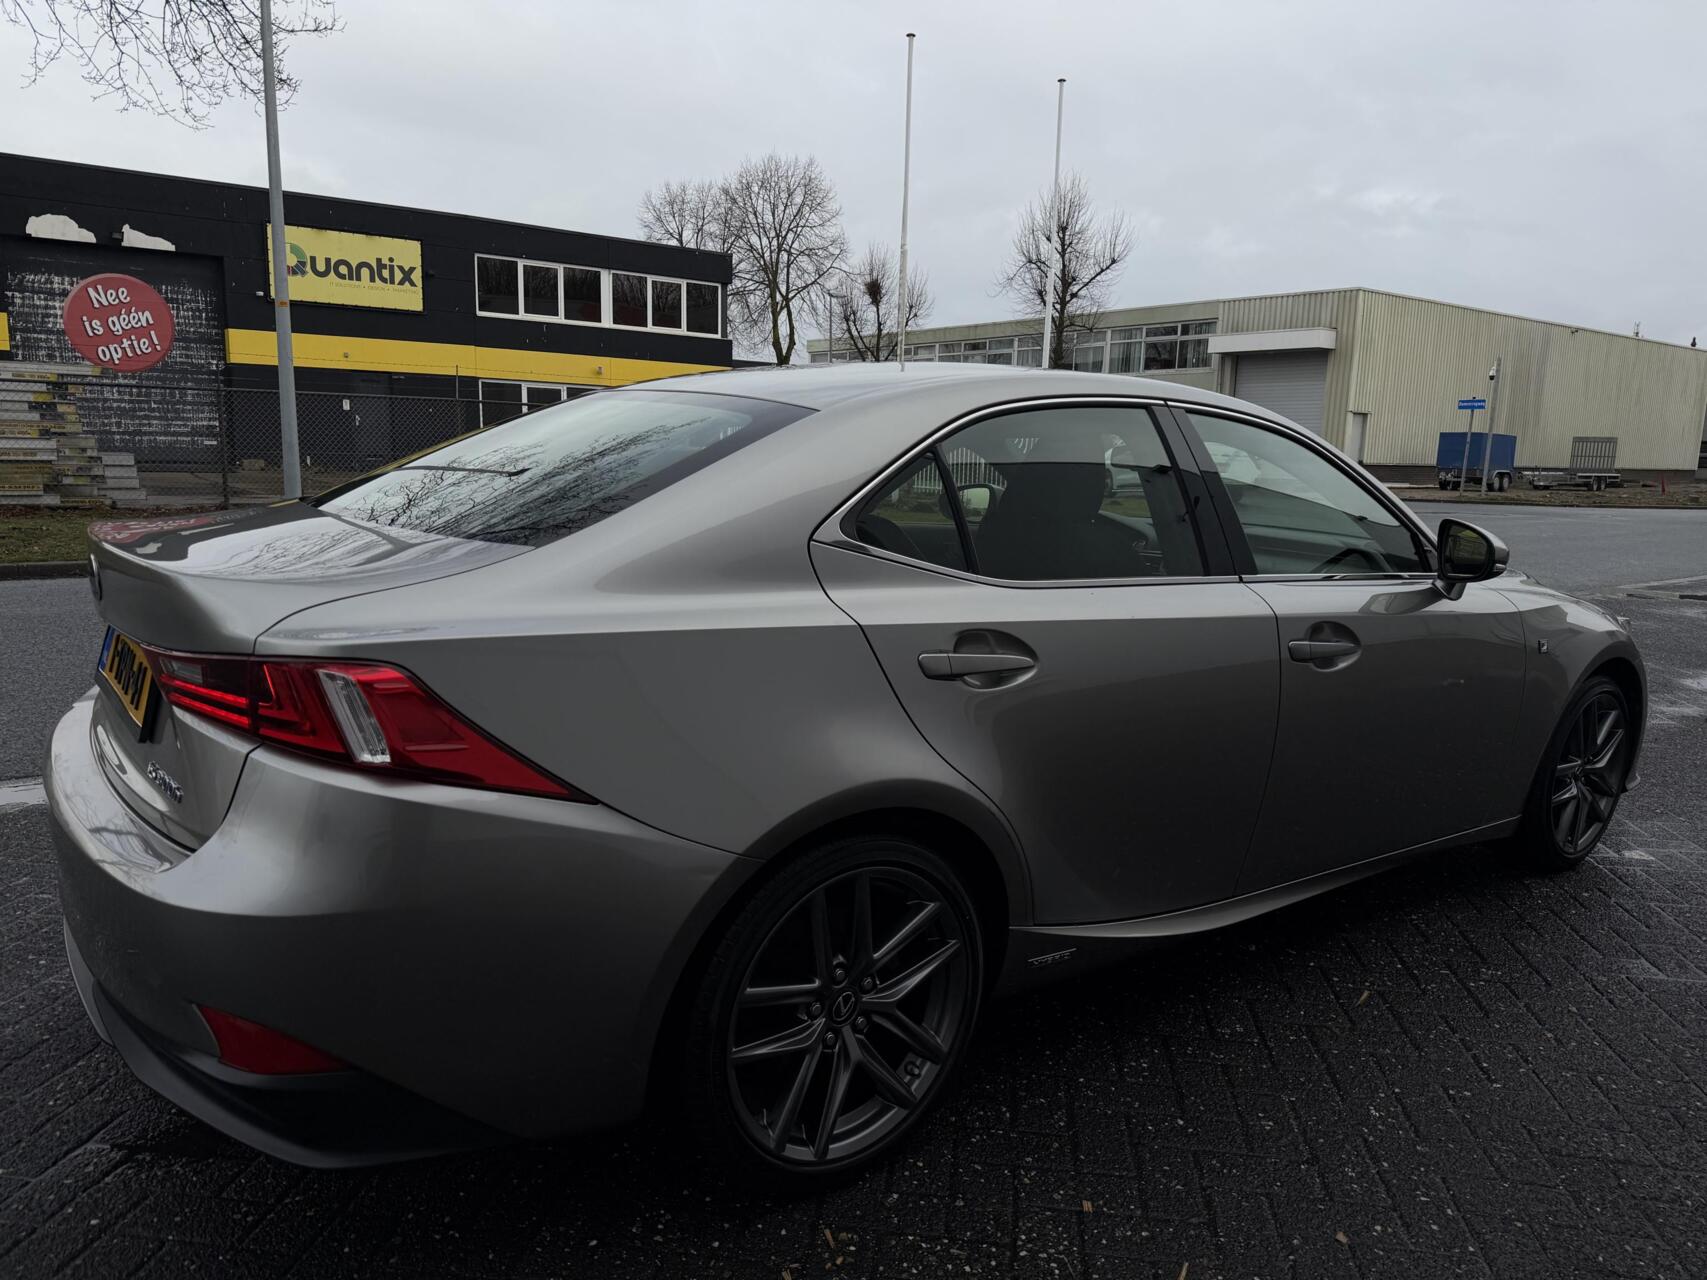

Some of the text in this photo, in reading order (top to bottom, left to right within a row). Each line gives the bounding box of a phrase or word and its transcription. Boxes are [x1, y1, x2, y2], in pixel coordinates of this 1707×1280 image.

[285, 242, 418, 288] Quantix
[87, 285, 131, 308] Nee
[82, 307, 154, 337] is géén
